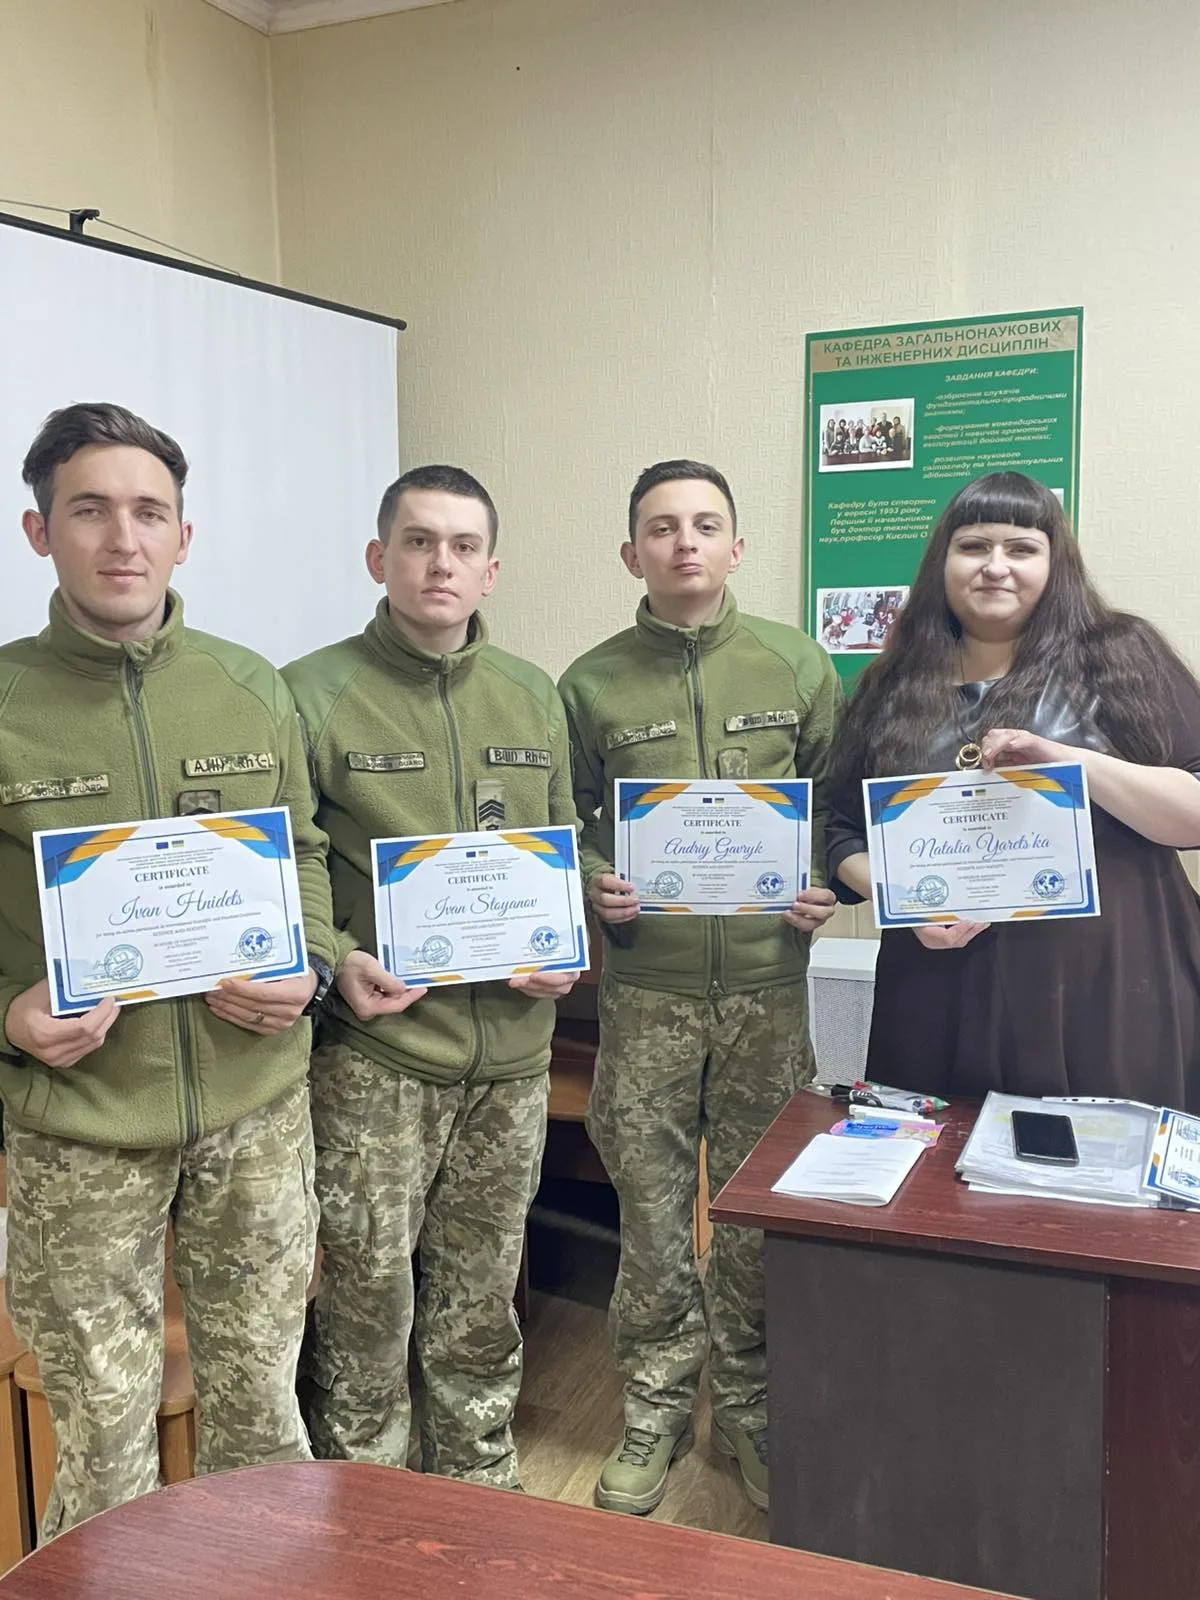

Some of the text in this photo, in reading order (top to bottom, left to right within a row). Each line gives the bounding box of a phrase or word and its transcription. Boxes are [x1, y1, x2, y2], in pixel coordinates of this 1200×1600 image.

[823, 320, 1062, 354] КАФЕДРА ЗАГАЛЬНОНАУКОВИХ
[834, 337, 1049, 367] ТА ІНЖЕНЕРНИХ ДИСЦИПЛІН
[944, 370, 993, 383] ЗАВДАННЯ
[683, 818, 742, 828] CERTIFICATE
[943, 811, 1009, 825] CERTIFICATE
[663, 836, 764, 862] Andriy Gavryk
[909, 837, 972, 860] Natalia
[134, 864, 210, 884] CERTIFICATE
[447, 872, 509, 885] CERTIFICATE
[108, 895, 162, 926] Ivan
[424, 896, 467, 921] Ivan
[470, 892, 538, 918] Stoyanov
